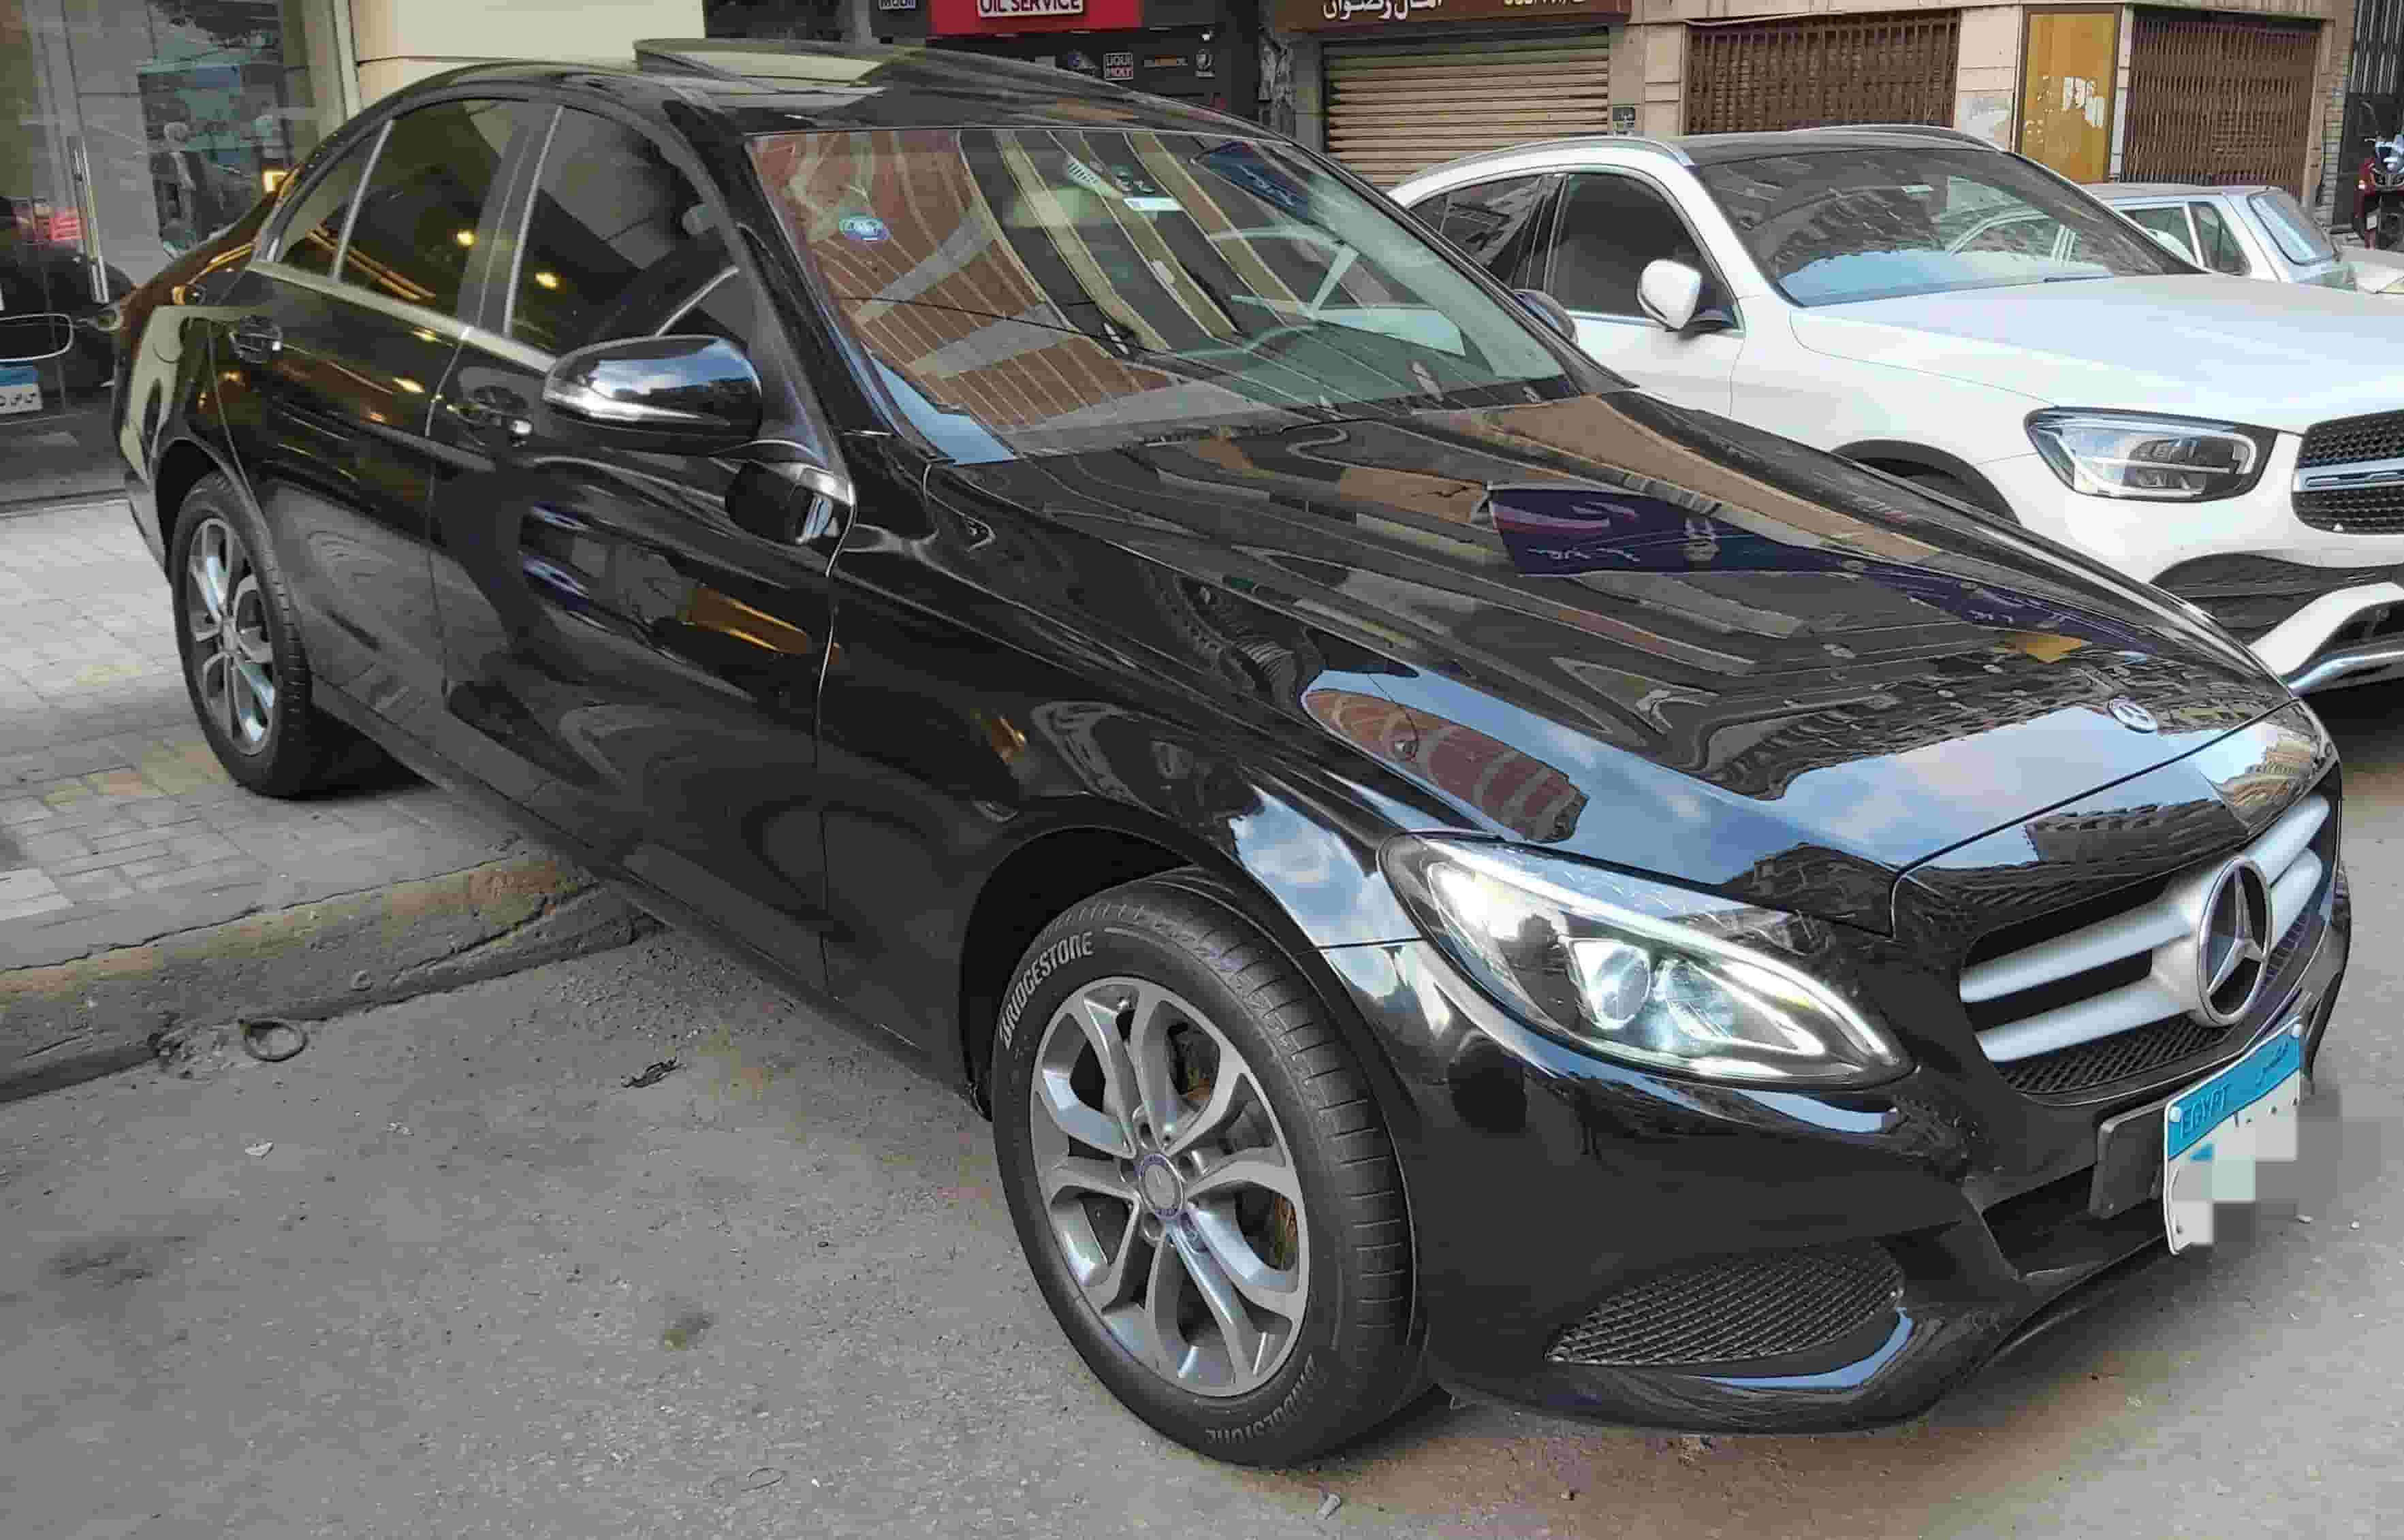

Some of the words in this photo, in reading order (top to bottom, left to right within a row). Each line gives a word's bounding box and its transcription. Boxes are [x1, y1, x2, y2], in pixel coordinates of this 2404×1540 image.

[979, 0, 1007, 12] OIL
[1012, 0, 1081, 12] SERVICE
[1000, 931, 1094, 1049] BRIDGESTONE
